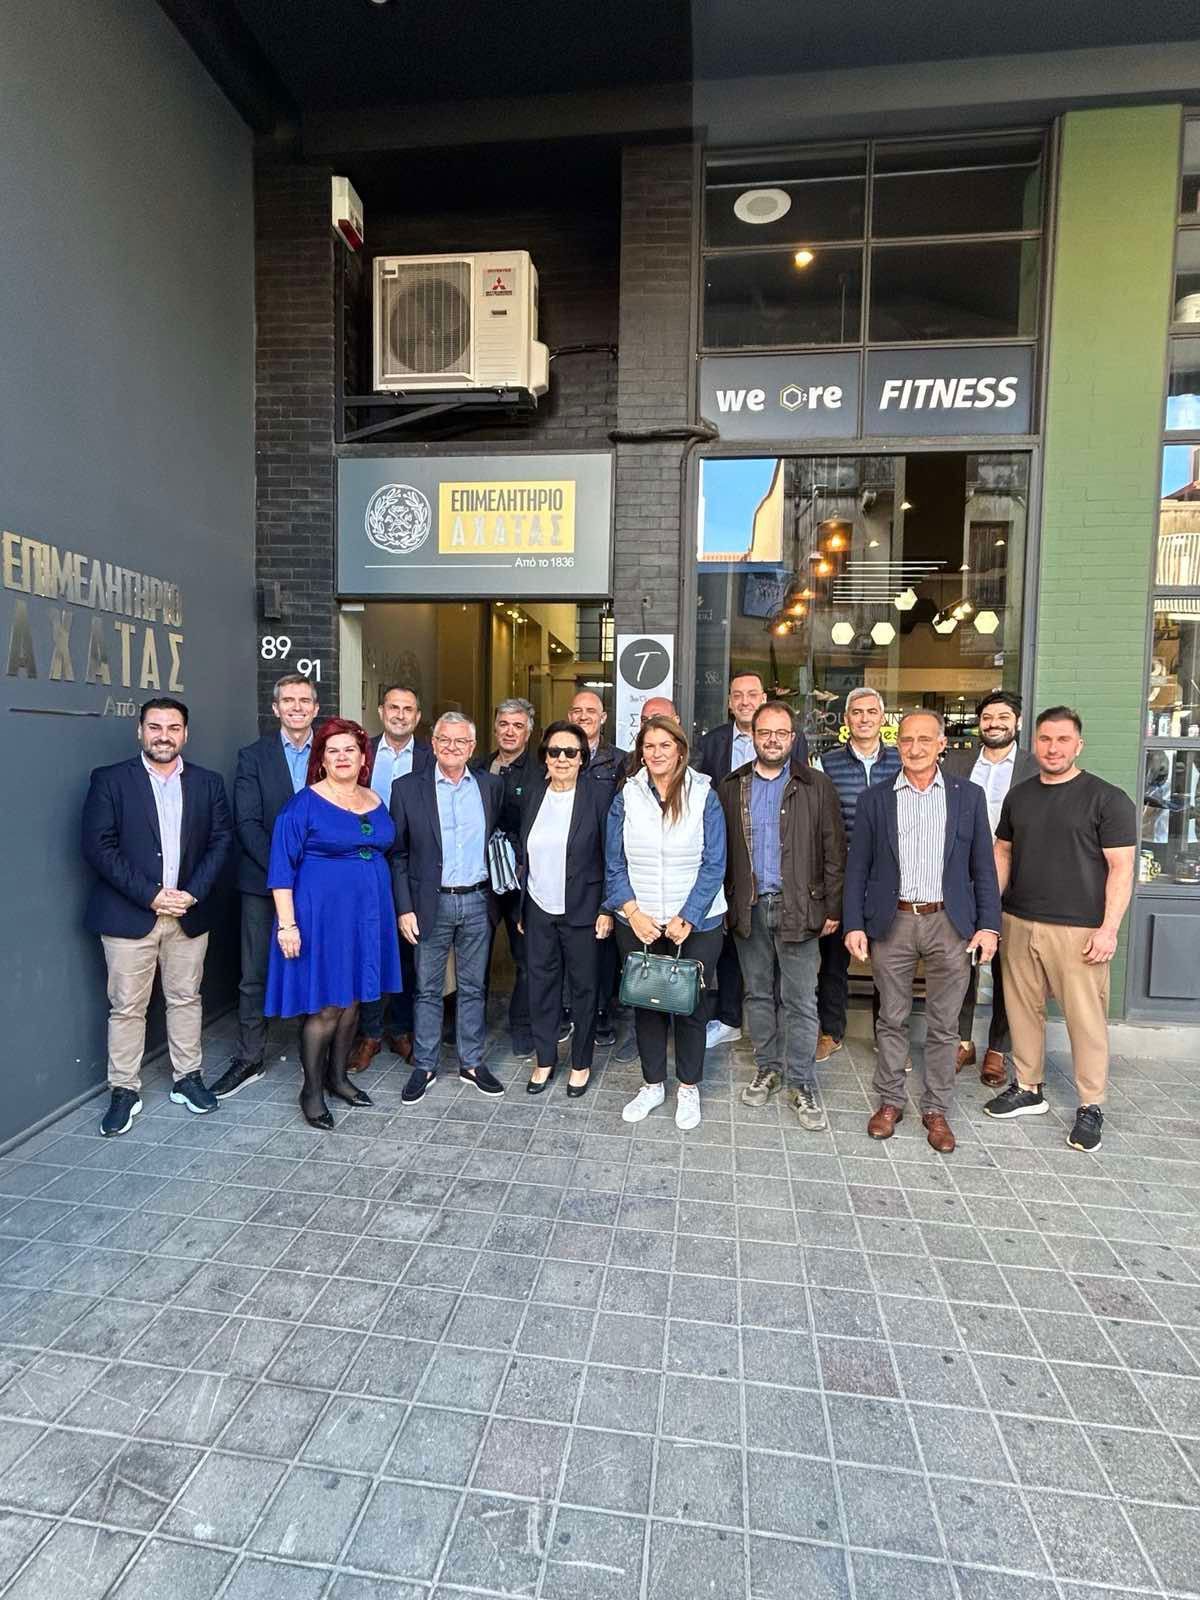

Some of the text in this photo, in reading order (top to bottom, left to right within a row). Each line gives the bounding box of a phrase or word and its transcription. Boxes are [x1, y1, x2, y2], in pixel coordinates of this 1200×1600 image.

[716, 388, 766, 412] we
[879, 376, 1018, 410] FITNESS
[451, 488, 563, 512] ΕΠΙΜΕΛΗΤΗΡΙΟ
[514, 556, 575, 568] Από το 1836
[2, 530, 184, 627] ΕΠΙΜΕΛΗΤΗΡΙΟ
[261, 635, 292, 660] 89
[296, 658, 321, 682] 91
[634, 651, 662, 682] T
[103, 695, 136, 717] Από
